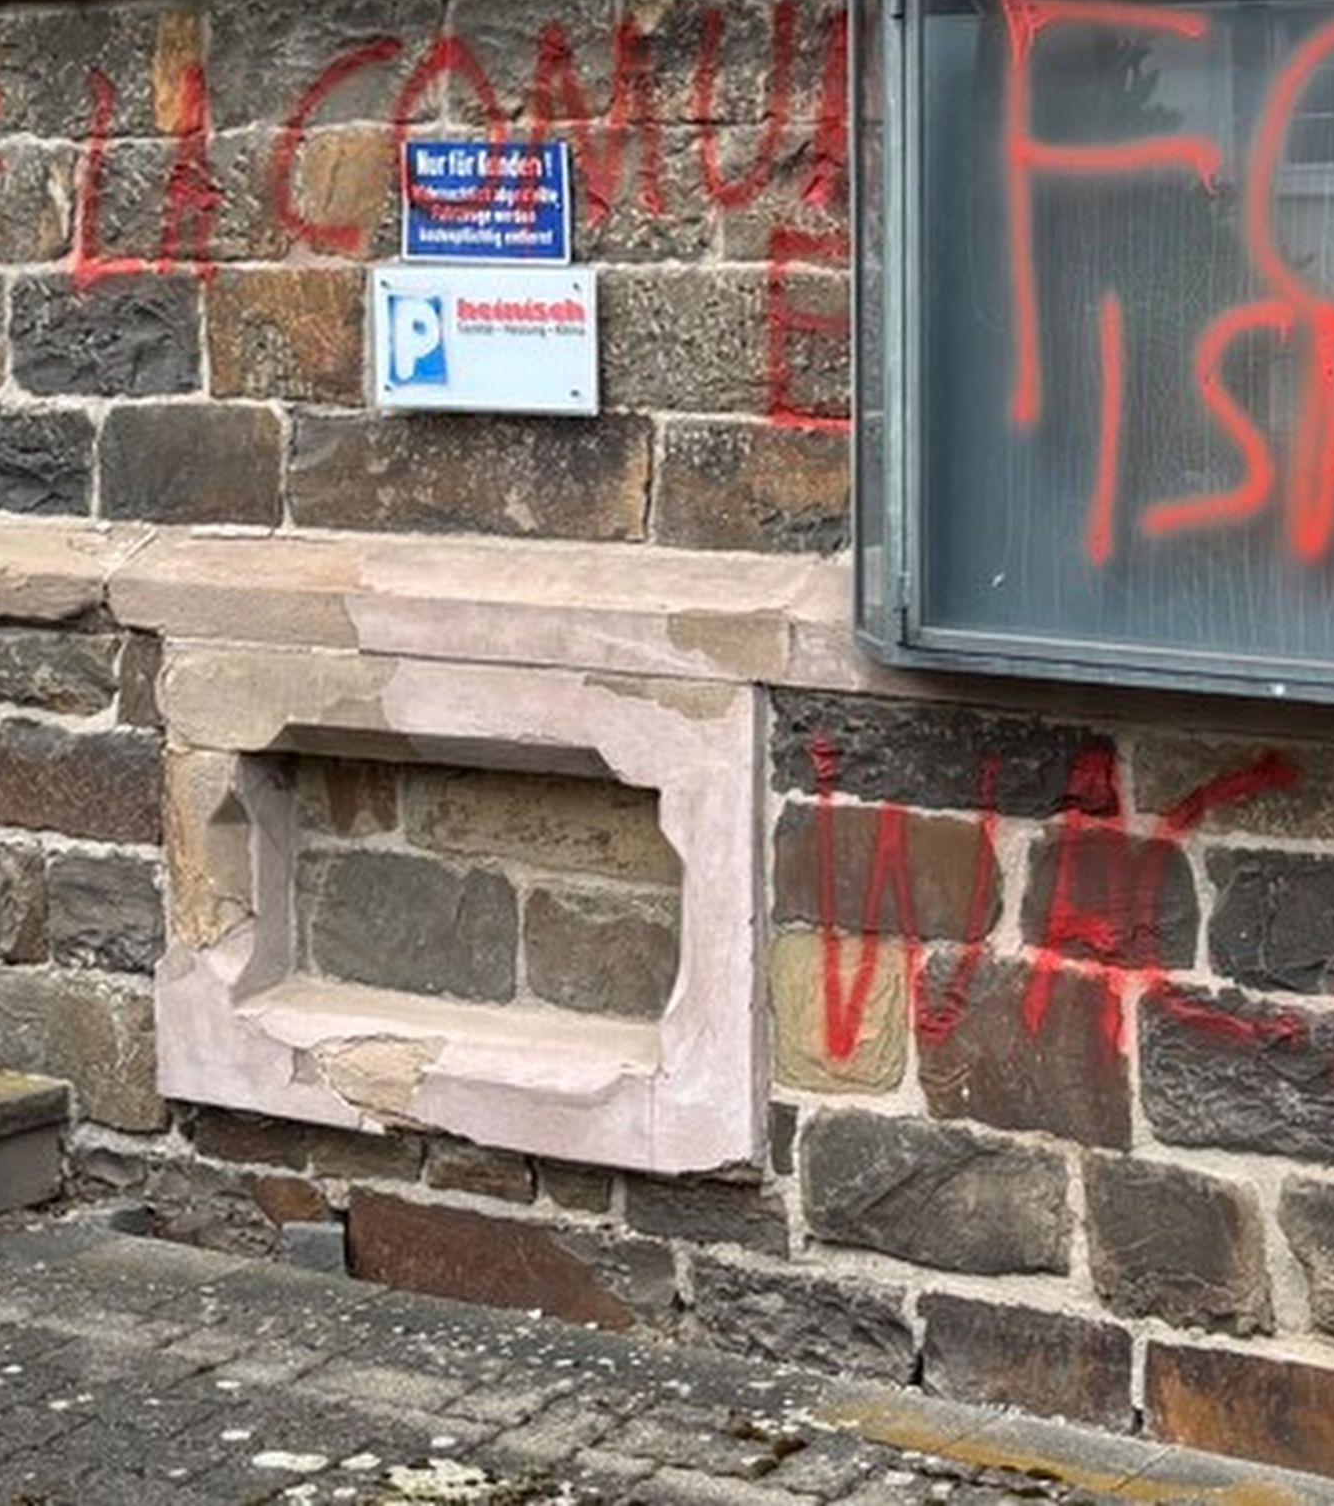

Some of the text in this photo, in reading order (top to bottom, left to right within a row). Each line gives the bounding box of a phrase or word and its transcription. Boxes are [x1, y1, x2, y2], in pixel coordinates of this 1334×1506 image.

[72, 62, 221, 290] LA
[416, 149, 446, 176] Nur
[449, 149, 474, 176] für
